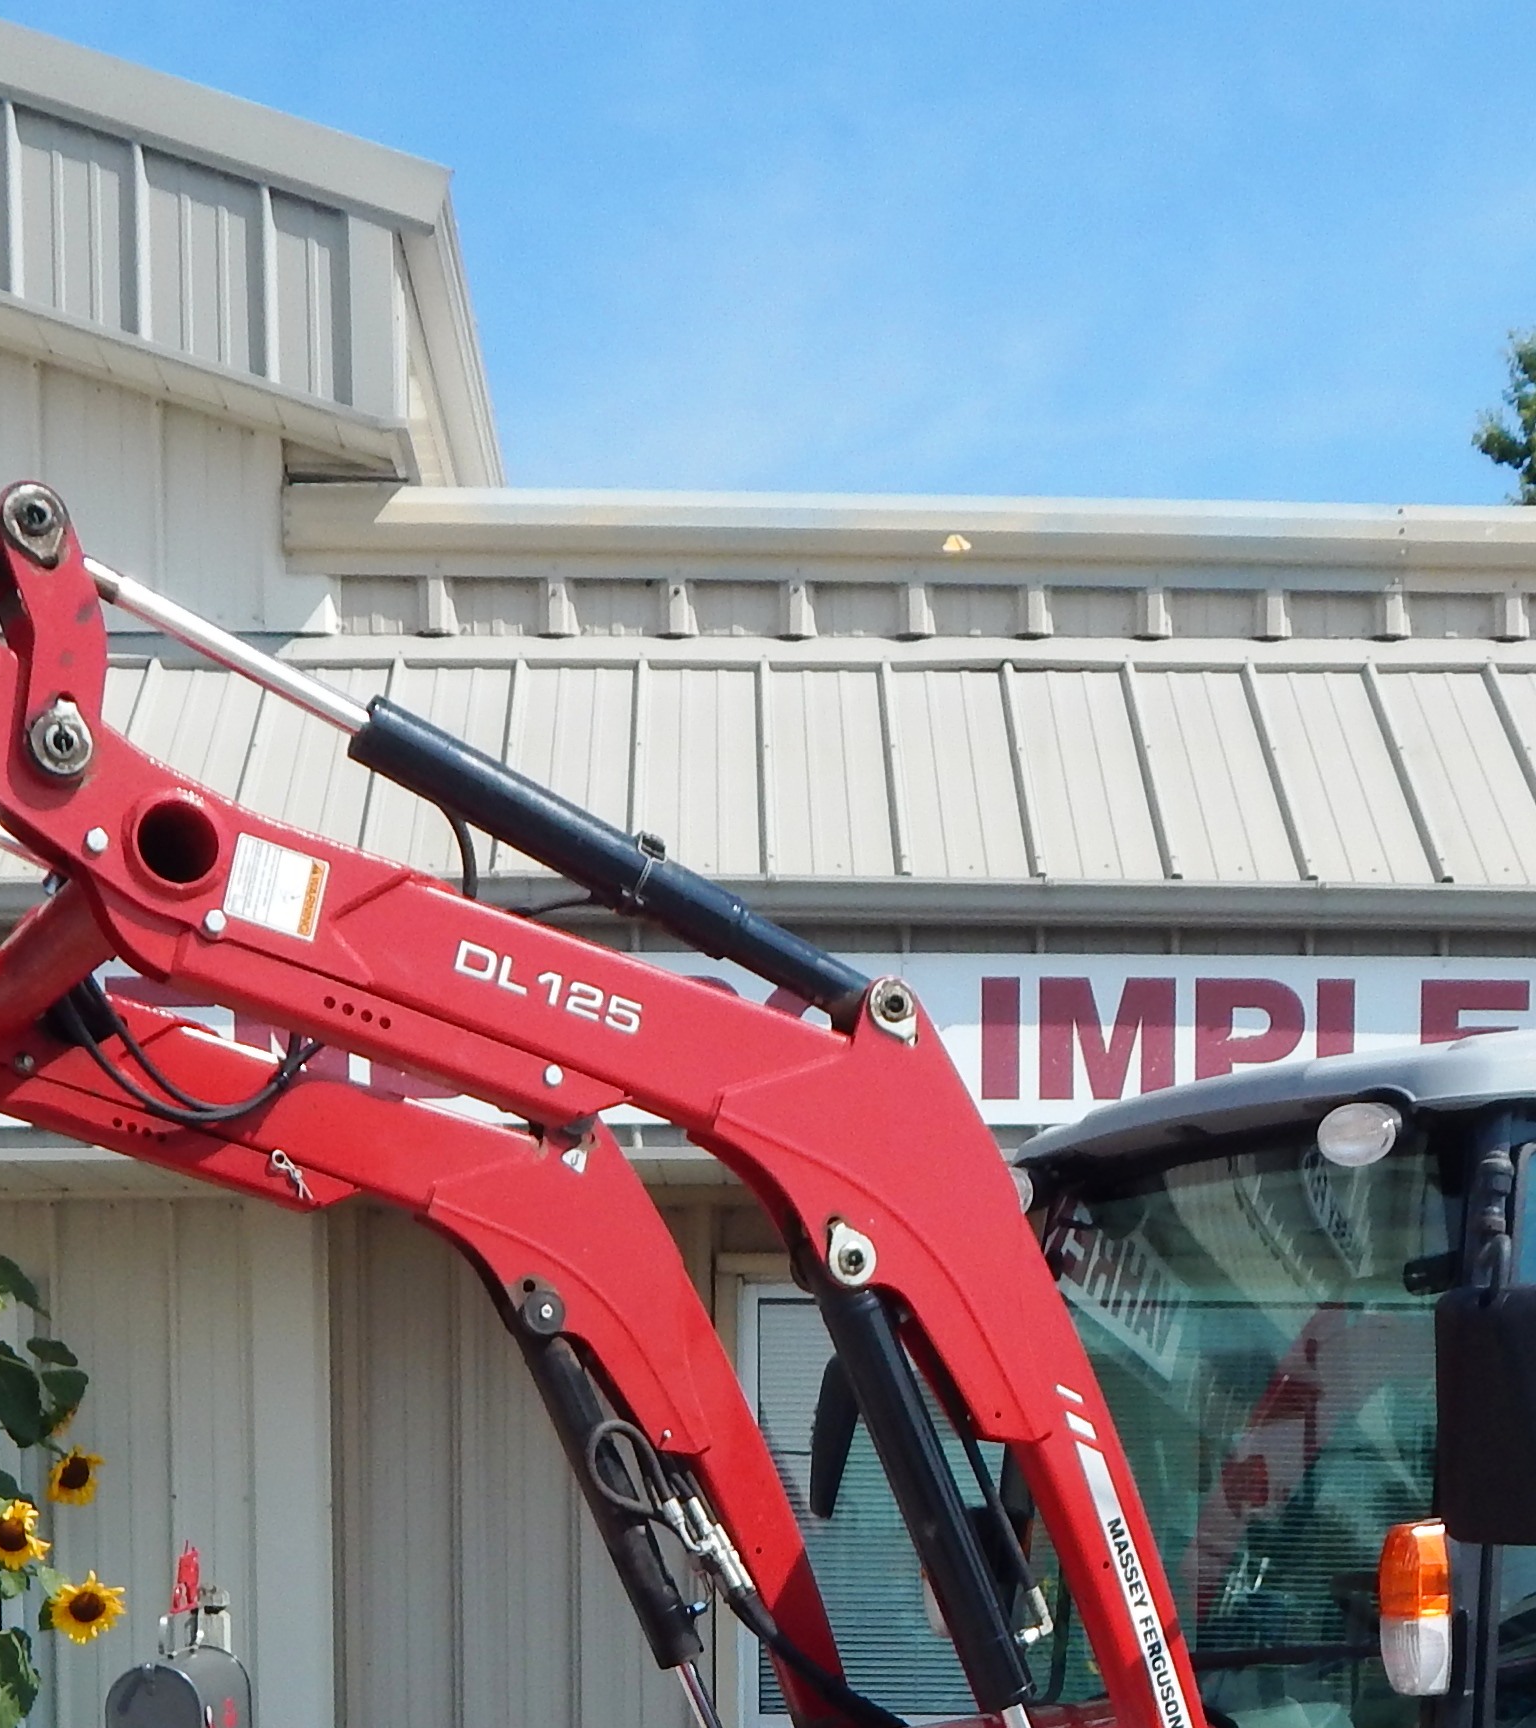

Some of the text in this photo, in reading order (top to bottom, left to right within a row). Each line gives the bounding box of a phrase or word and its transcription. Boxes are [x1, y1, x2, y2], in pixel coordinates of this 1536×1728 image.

[454, 939, 643, 1035] DL 125
[1107, 1517, 1149, 1608] MASSEY
